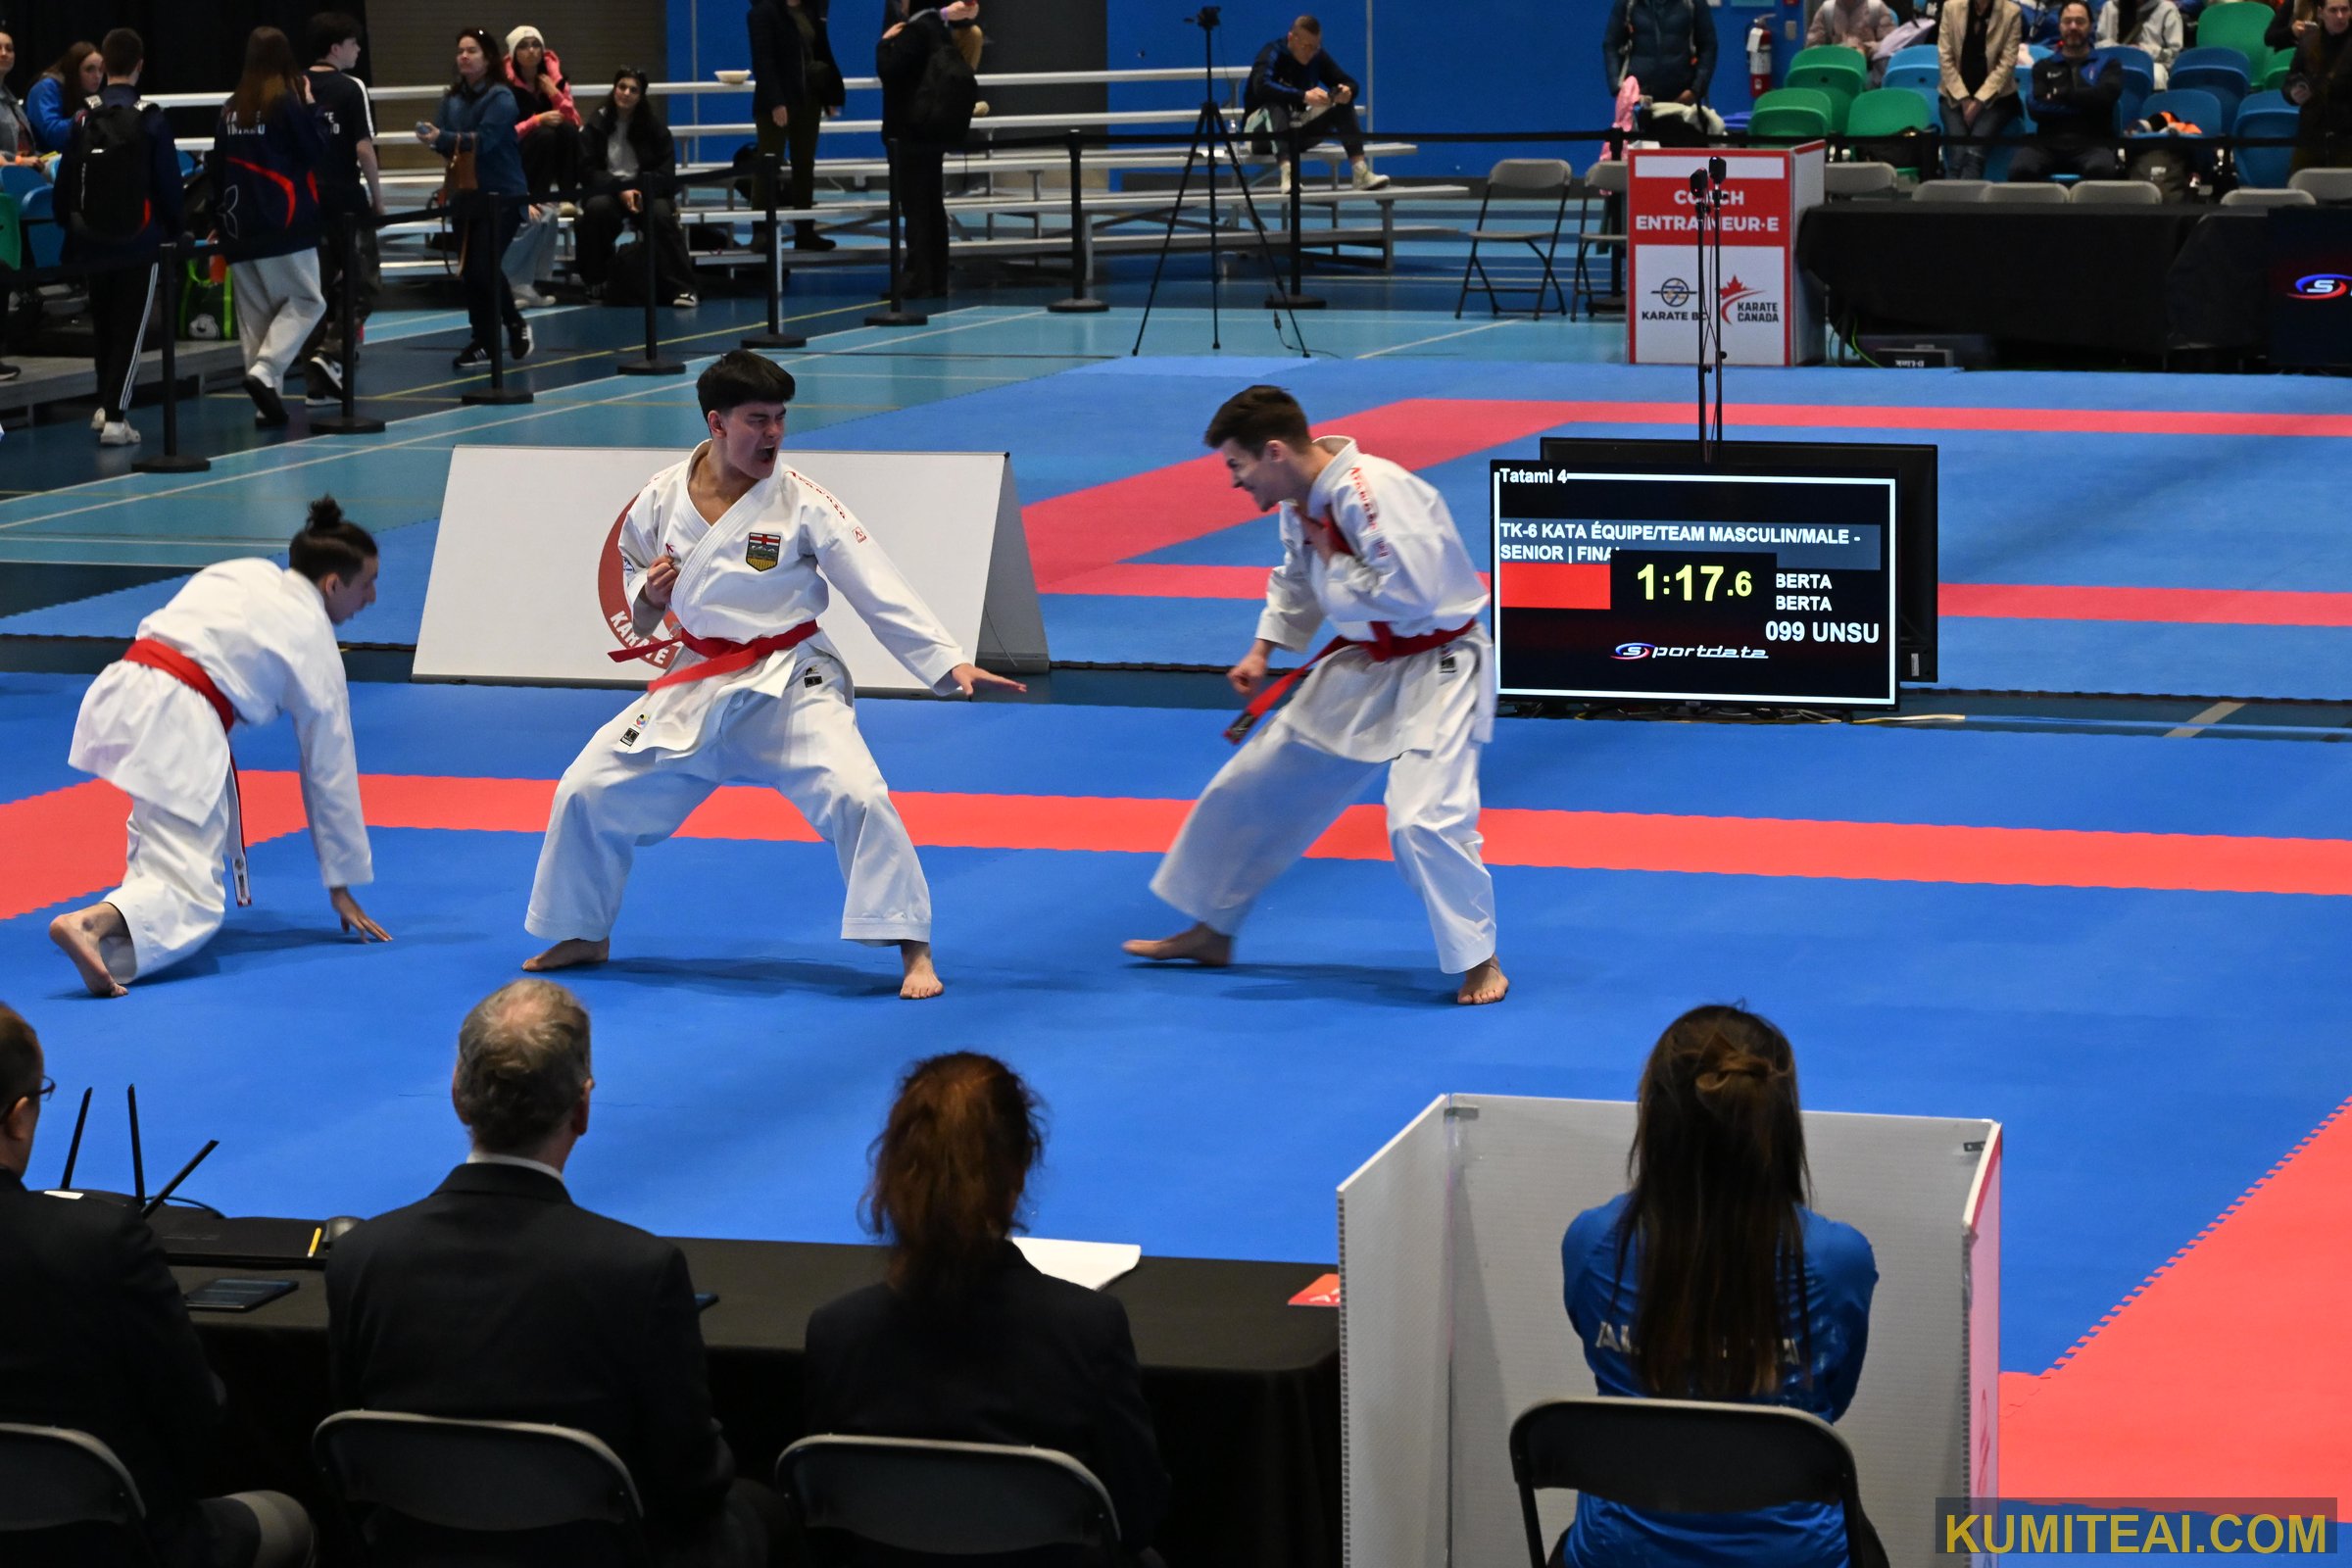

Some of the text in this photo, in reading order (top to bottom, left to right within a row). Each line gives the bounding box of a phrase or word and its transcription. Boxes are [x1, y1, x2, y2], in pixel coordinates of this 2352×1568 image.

[1642, 311, 1688, 320] KARATE
[1738, 302, 1778, 312] KARATE
[1738, 313, 1779, 322] CANADA
[1499, 467, 1568, 484] Tatami 4
[1500, 522, 1538, 538] TK-6
[1542, 523, 1587, 539] KATA
[1591, 520, 1704, 541] ÉQUIPE/TEAM
[1709, 526, 1849, 545] MASCULIN/MALE
[1500, 544, 1564, 561] SENIOR
[1577, 546, 1620, 562] FINA
[1637, 564, 1752, 601] 1:17.6
[1776, 573, 1833, 589] BERTA
[1776, 595, 1833, 612] BERTA
[610, 610, 669, 664] KARE
[1765, 620, 1879, 643] 099 UNSU
